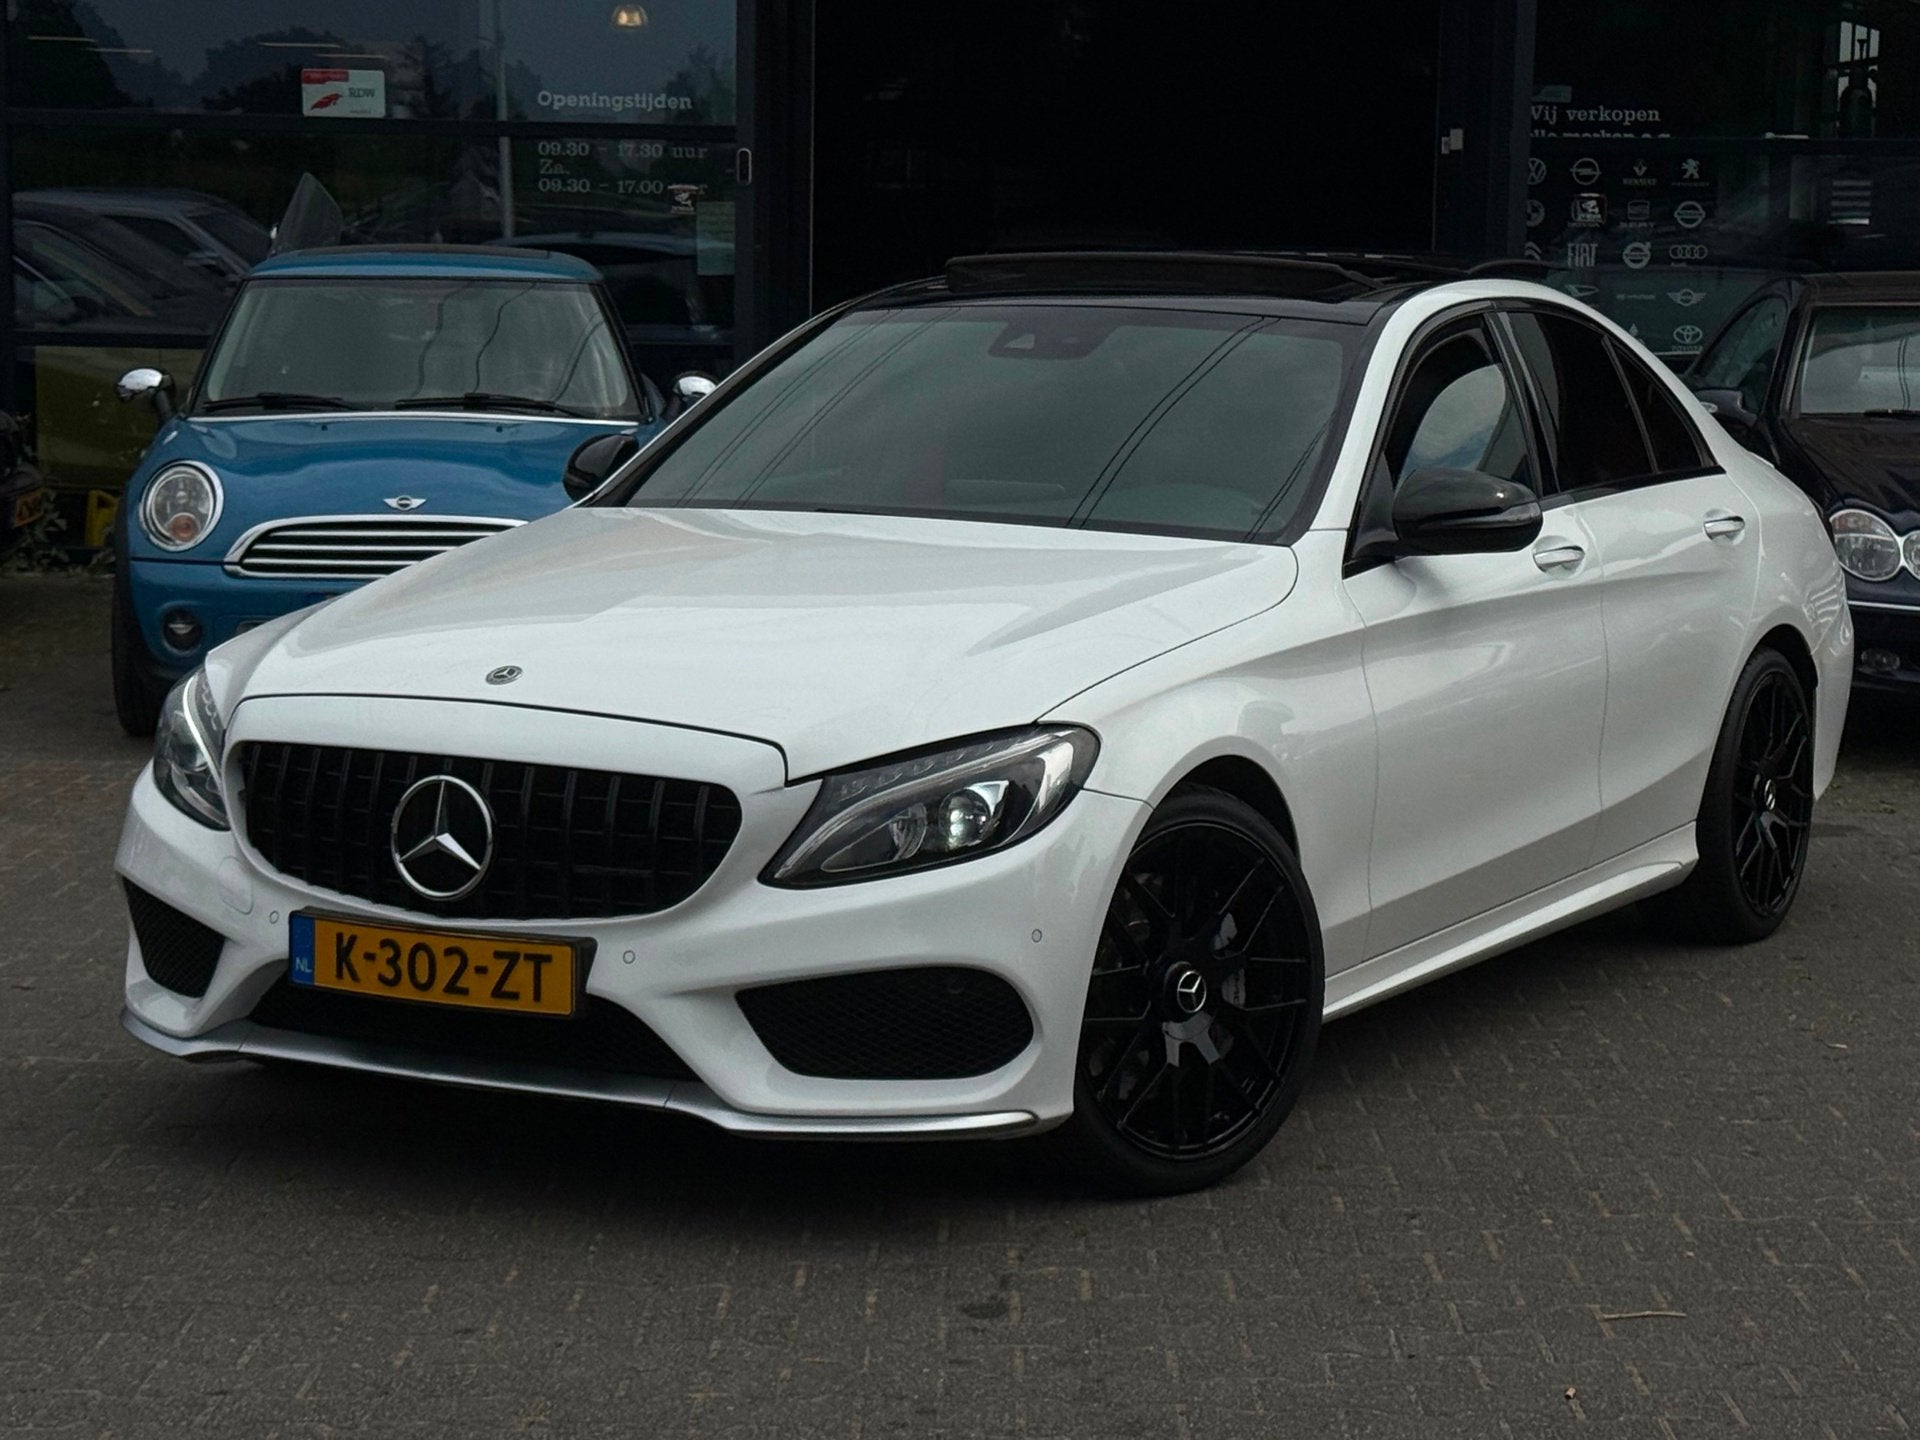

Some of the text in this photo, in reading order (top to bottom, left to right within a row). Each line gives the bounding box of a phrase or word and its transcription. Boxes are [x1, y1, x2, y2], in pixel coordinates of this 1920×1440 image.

[537, 90, 693, 111] Openingstijden
[1566, 105, 1661, 126] verkopen
[538, 141, 590, 156] 09.30
[617, 143, 663, 158] 17.30
[672, 147, 708, 158] uur
[539, 159, 570, 174] Za.
[538, 178, 591, 193] 09.30
[617, 180, 663, 194] 17.00
[1567, 243, 1599, 268] FIAT
[295, 956, 312, 973] NL
[335, 932, 552, 1003] K-302-ZT
